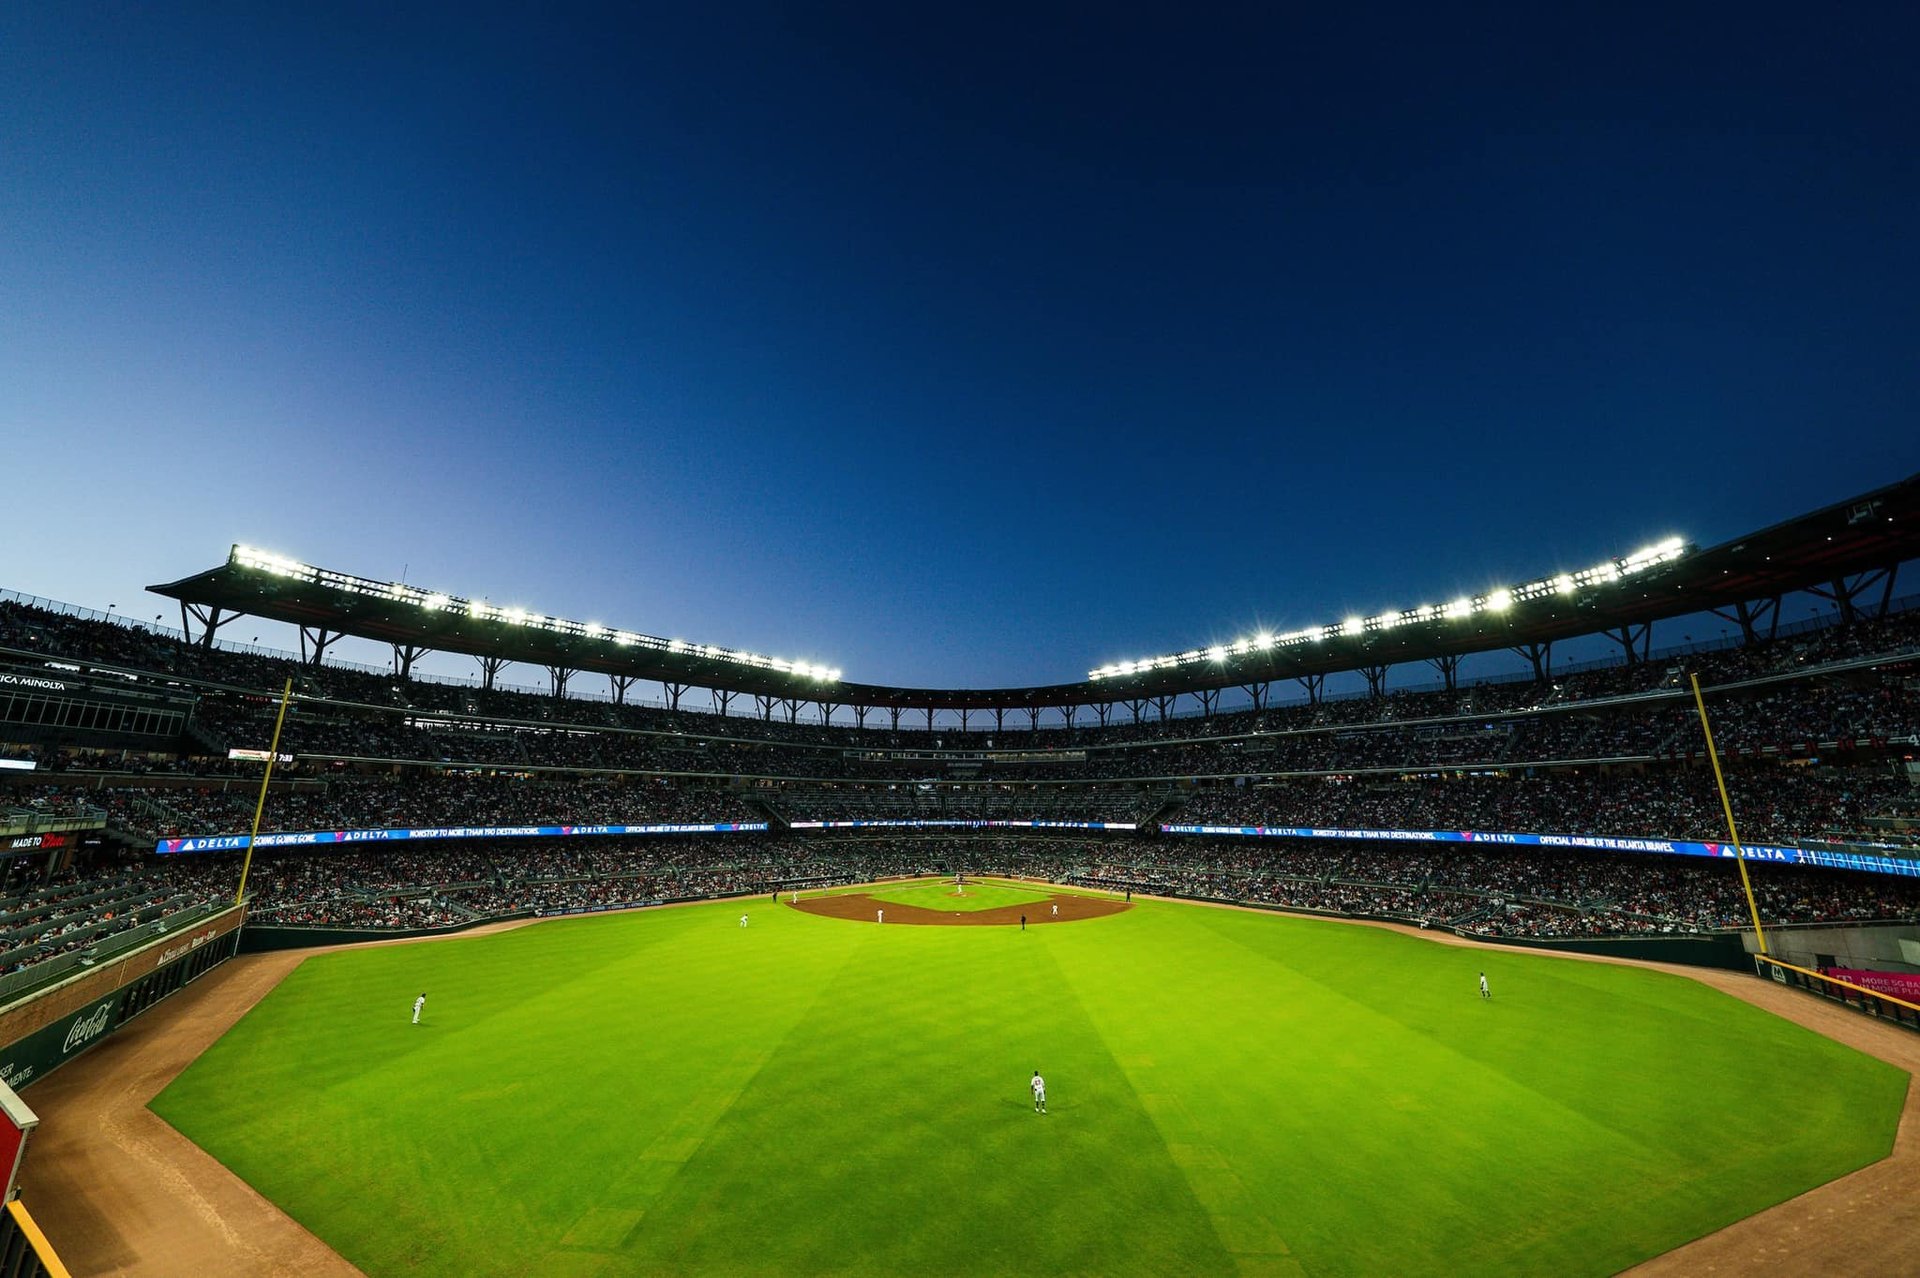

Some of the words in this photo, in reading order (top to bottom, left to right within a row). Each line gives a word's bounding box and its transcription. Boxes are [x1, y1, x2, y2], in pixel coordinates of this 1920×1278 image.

[0, 674, 17, 684] ICA
[20, 678, 65, 691] MINOLTA
[410, 829, 438, 838] NONSTOP
[440, 829, 448, 837] TO
[448, 828, 465, 837] MORE
[466, 828, 484, 837] THAN
[581, 826, 608, 834] DELTA
[1273, 828, 1297, 836] DELTA
[1313, 829, 1337, 838] NONSTOP
[1338, 830, 1346, 838] TO
[1346, 830, 1362, 838] MORE
[1363, 831, 1380, 839] THAN
[253, 835, 276, 847] GOING
[276, 834, 298, 846] GOING
[345, 831, 389, 841] DELTA
[1484, 833, 1516, 843] DELTA
[12, 837, 32, 848] MADE
[32, 836, 42, 847] TO
[198, 838, 239, 849] DELTA
[1540, 835, 1570, 846] OFFICIAL
[1572, 836, 1596, 848] AIRLINE
[1596, 838, 1604, 848] OF
[1605, 838, 1617, 849] THE
[1617, 839, 1645, 851] ATLANTA
[1821, 852, 1834, 866] 2
[1835, 853, 1847, 868] 3
[1850, 854, 1862, 870] 4
[1865, 855, 1877, 872] 5
[1897, 858, 1910, 875] 7
[1861, 977, 1889, 986] MORE
[1891, 979, 1905, 988] 5G
[1907, 980, 1920, 989] BA
